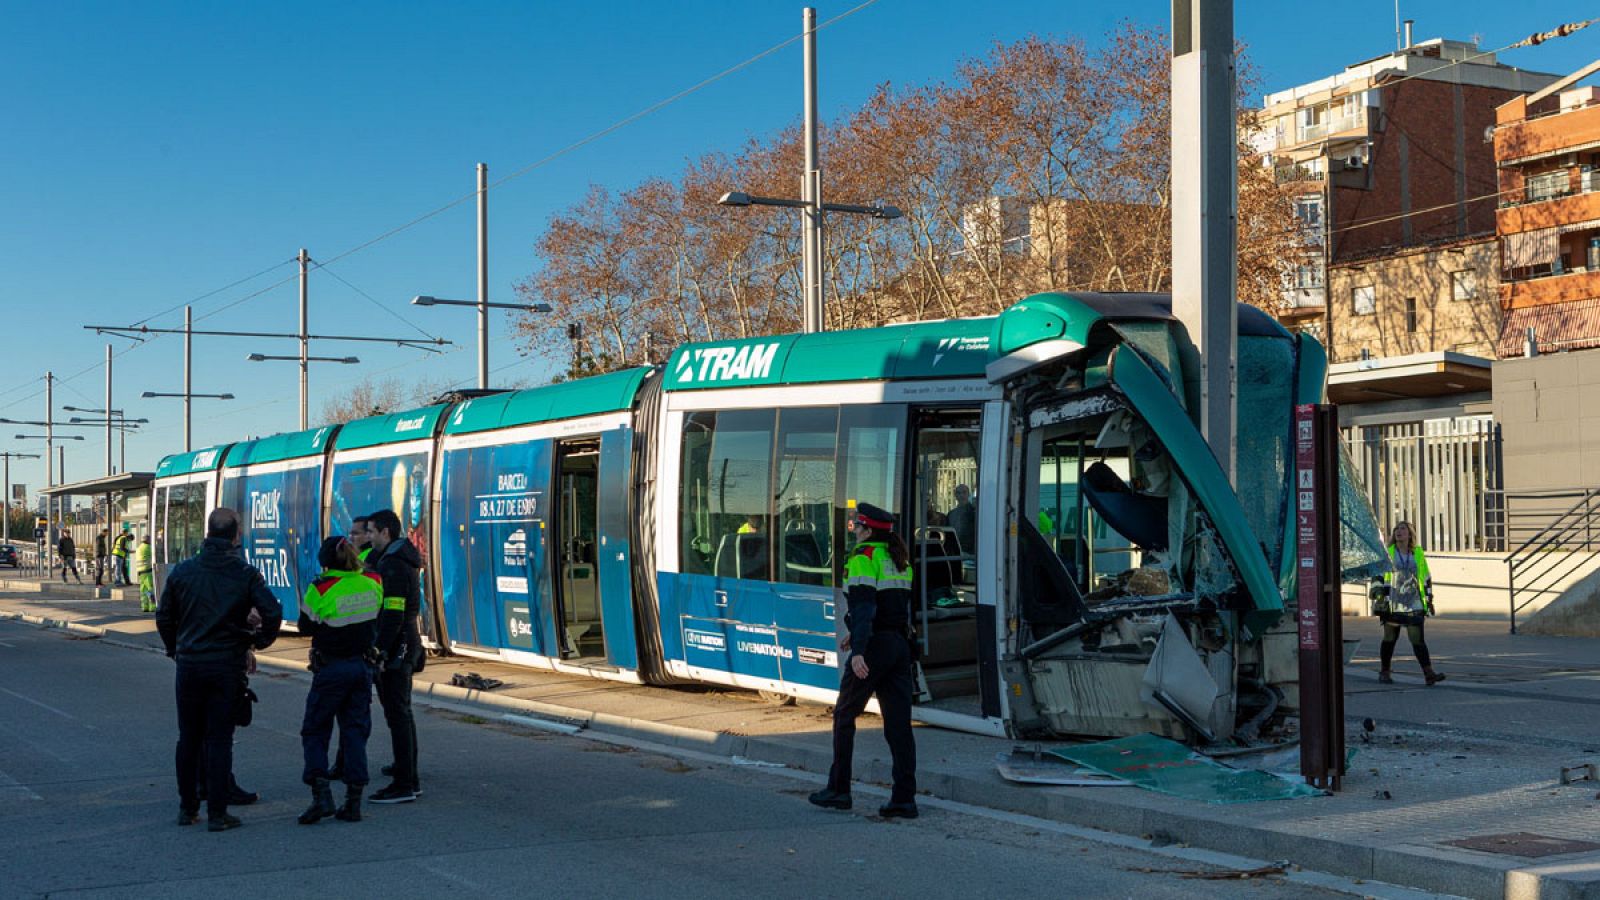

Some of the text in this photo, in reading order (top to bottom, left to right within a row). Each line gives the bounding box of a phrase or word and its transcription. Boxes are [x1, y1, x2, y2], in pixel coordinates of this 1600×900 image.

[697, 343, 780, 382] TRAM
[496, 500, 505, 517] 27
[506, 500, 516, 516] DE
